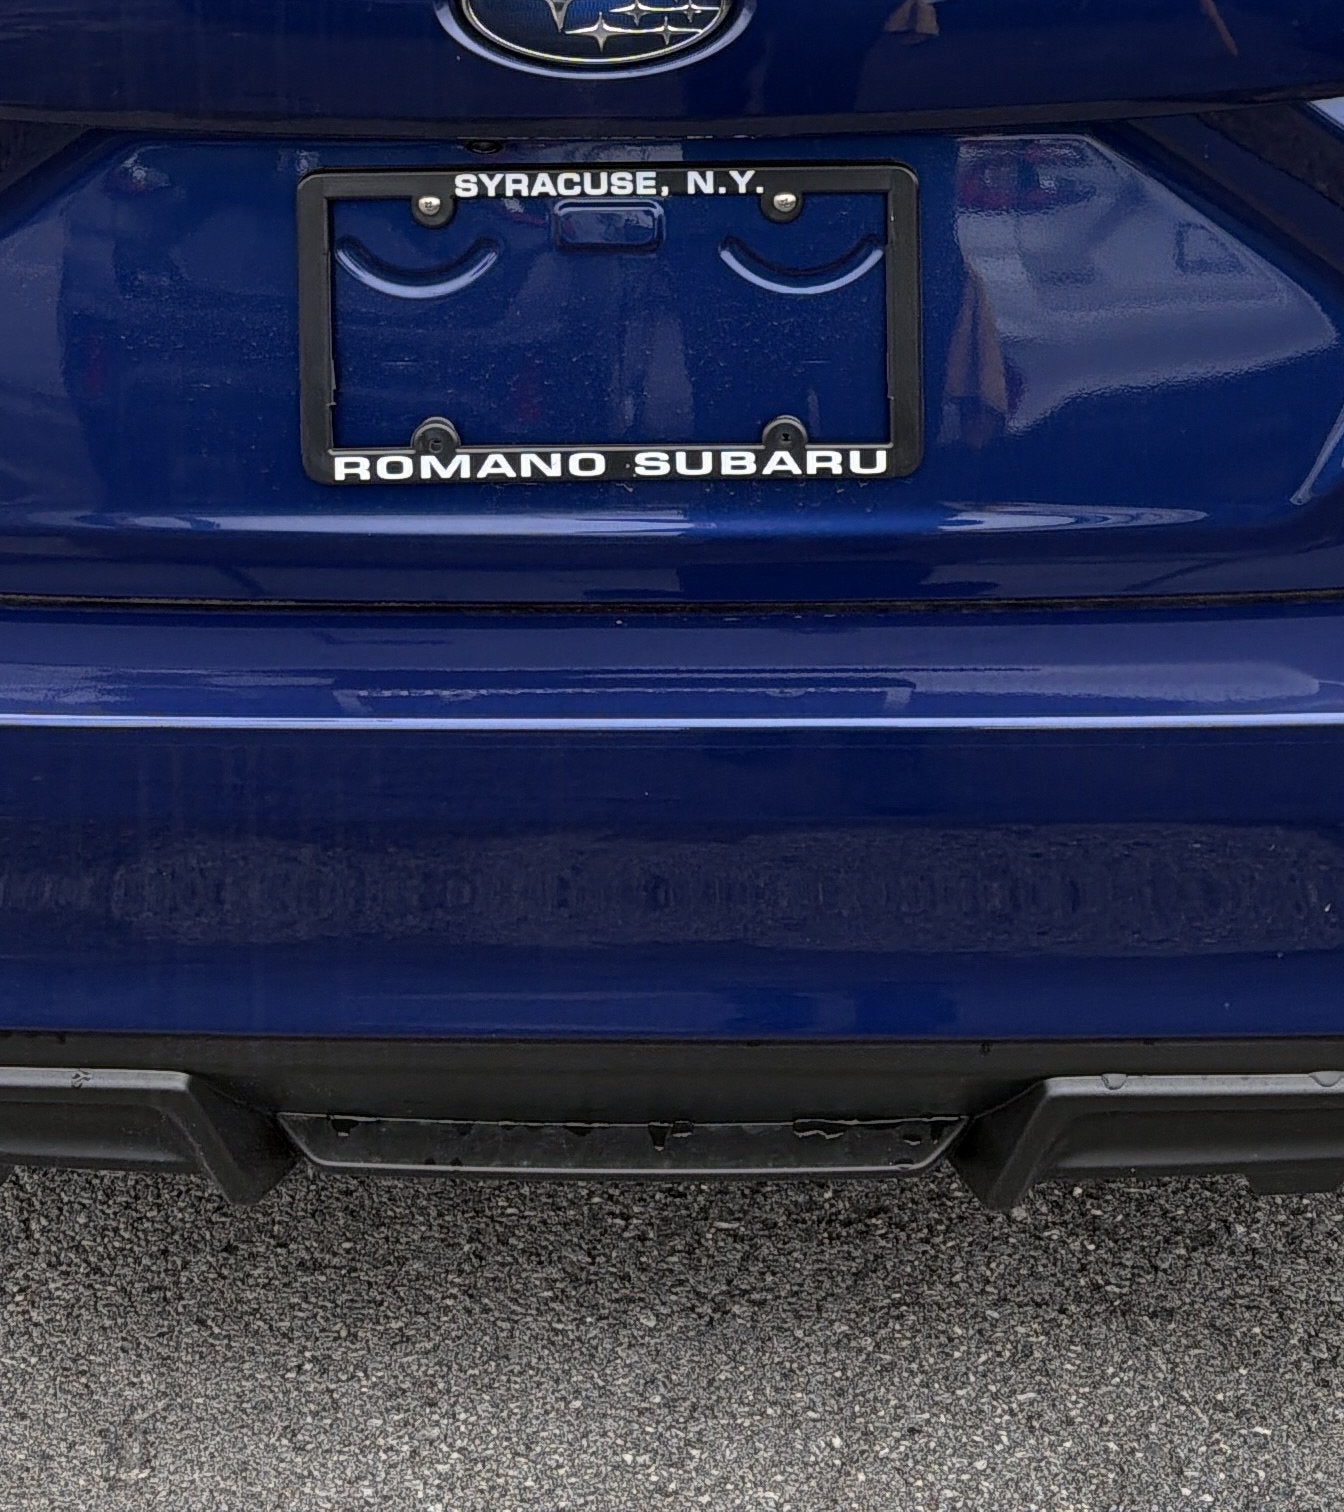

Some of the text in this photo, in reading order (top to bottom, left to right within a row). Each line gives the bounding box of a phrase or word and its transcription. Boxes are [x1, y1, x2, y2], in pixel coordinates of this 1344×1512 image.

[454, 169, 765, 198] SYRACUSE, N.Y.
[333, 450, 888, 481] ROMANO SUBARU
